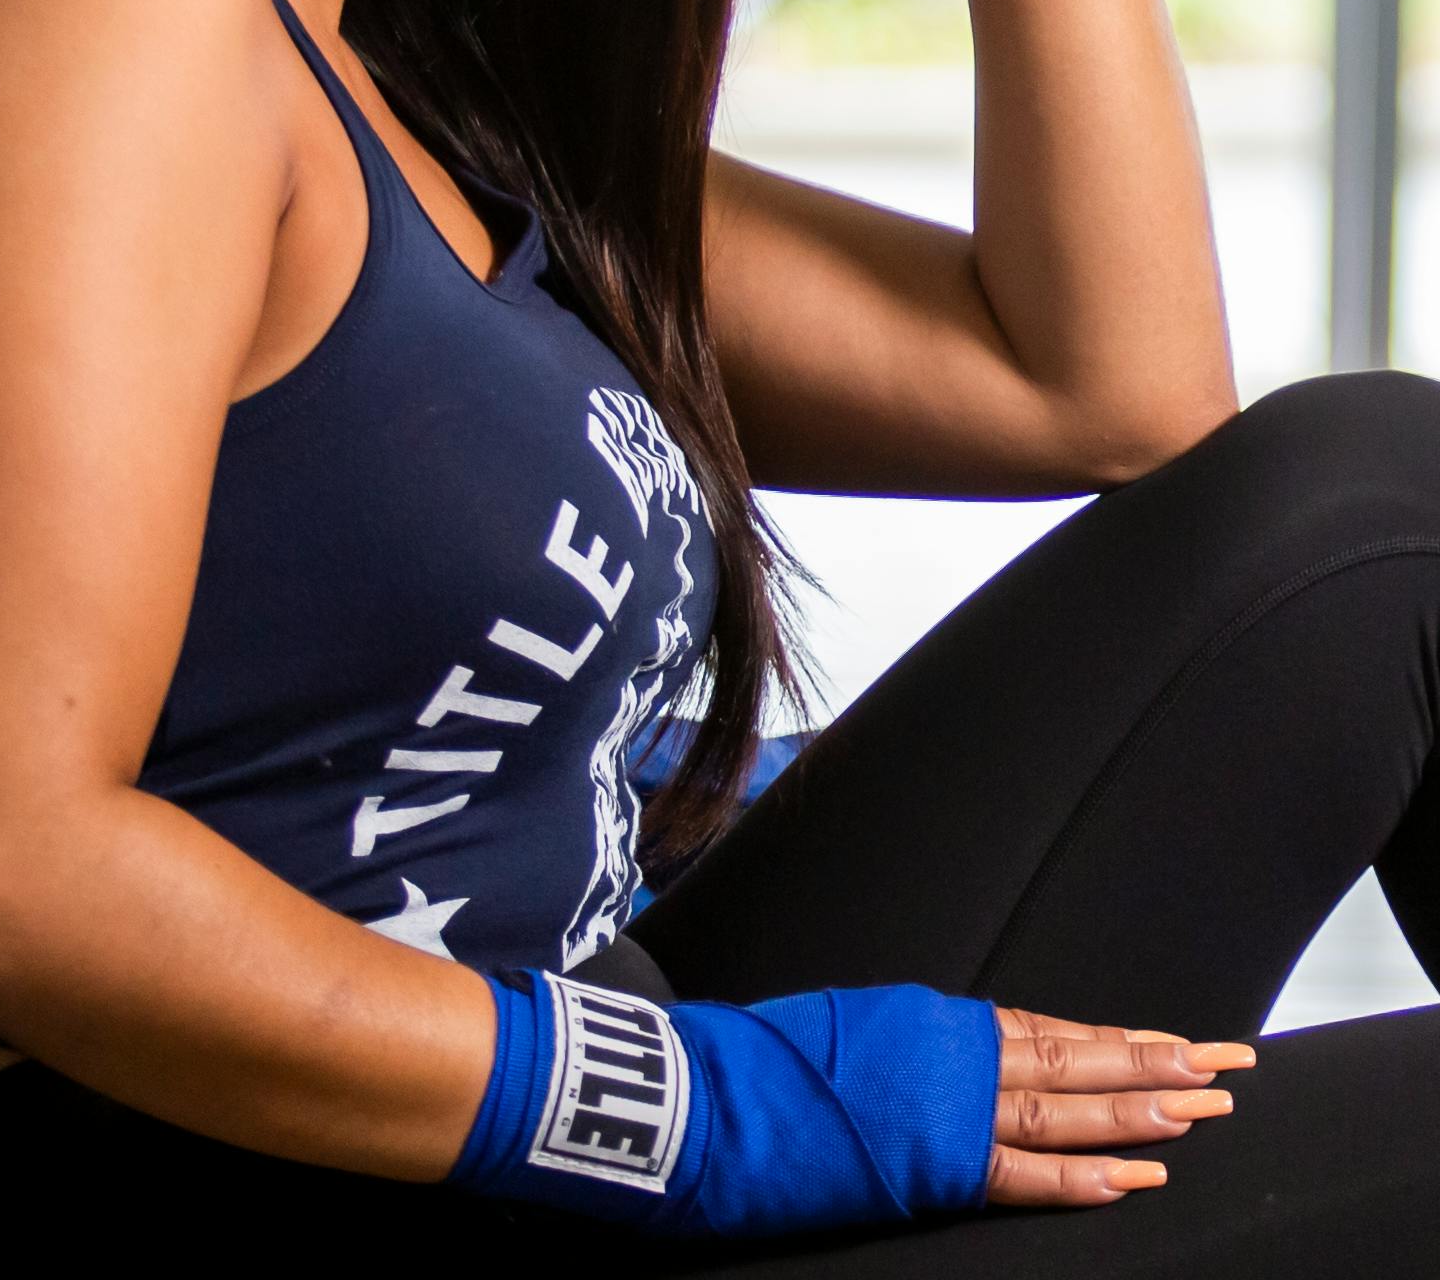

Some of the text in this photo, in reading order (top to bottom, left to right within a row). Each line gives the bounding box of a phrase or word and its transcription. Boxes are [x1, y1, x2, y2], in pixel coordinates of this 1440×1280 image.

[351, 498, 635, 857] TITLE
[561, 996, 584, 1128] BOXING
[567, 995, 666, 1158] TITLE
